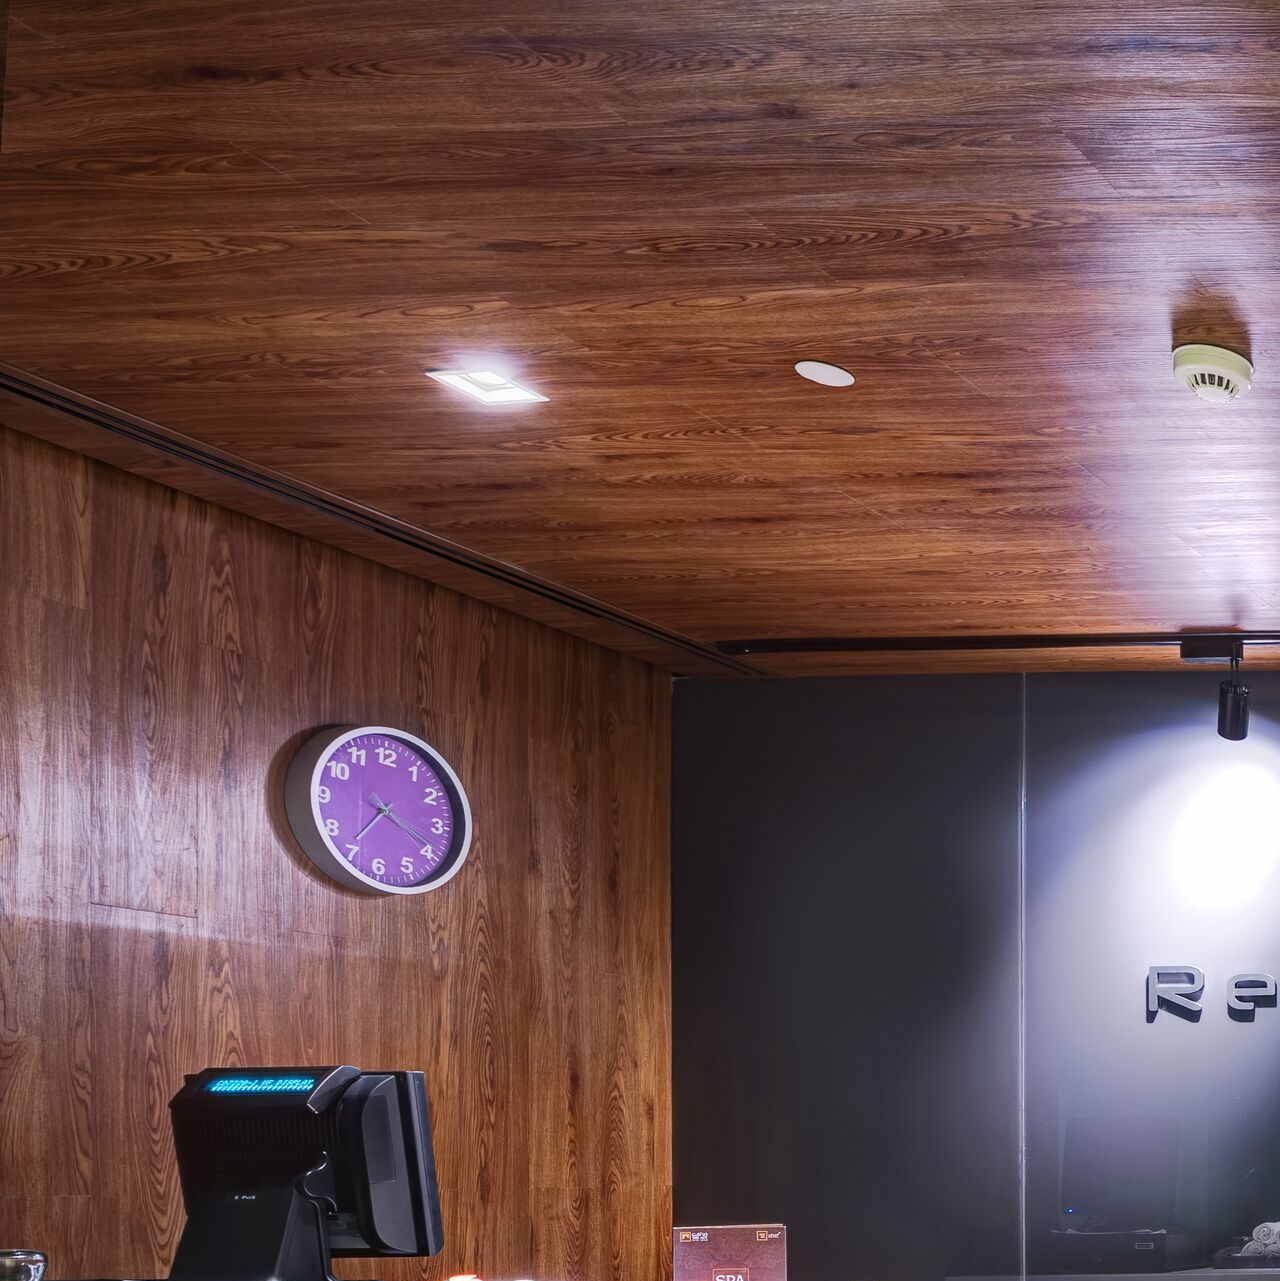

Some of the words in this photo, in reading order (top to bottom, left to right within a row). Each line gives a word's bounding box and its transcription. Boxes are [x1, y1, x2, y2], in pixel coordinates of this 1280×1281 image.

[348, 747, 366, 766] 11
[375, 748, 397, 767] 12
[327, 761, 349, 780] 10
[409, 767, 418, 782] 1
[319, 786, 331, 803] 9
[424, 788, 437, 805] 2
[326, 819, 339, 836] 8
[431, 818, 443, 835] 3
[345, 844, 359, 861] 7
[420, 845, 433, 859] 4
[371, 858, 385, 875] 6
[400, 857, 414, 874] 5
